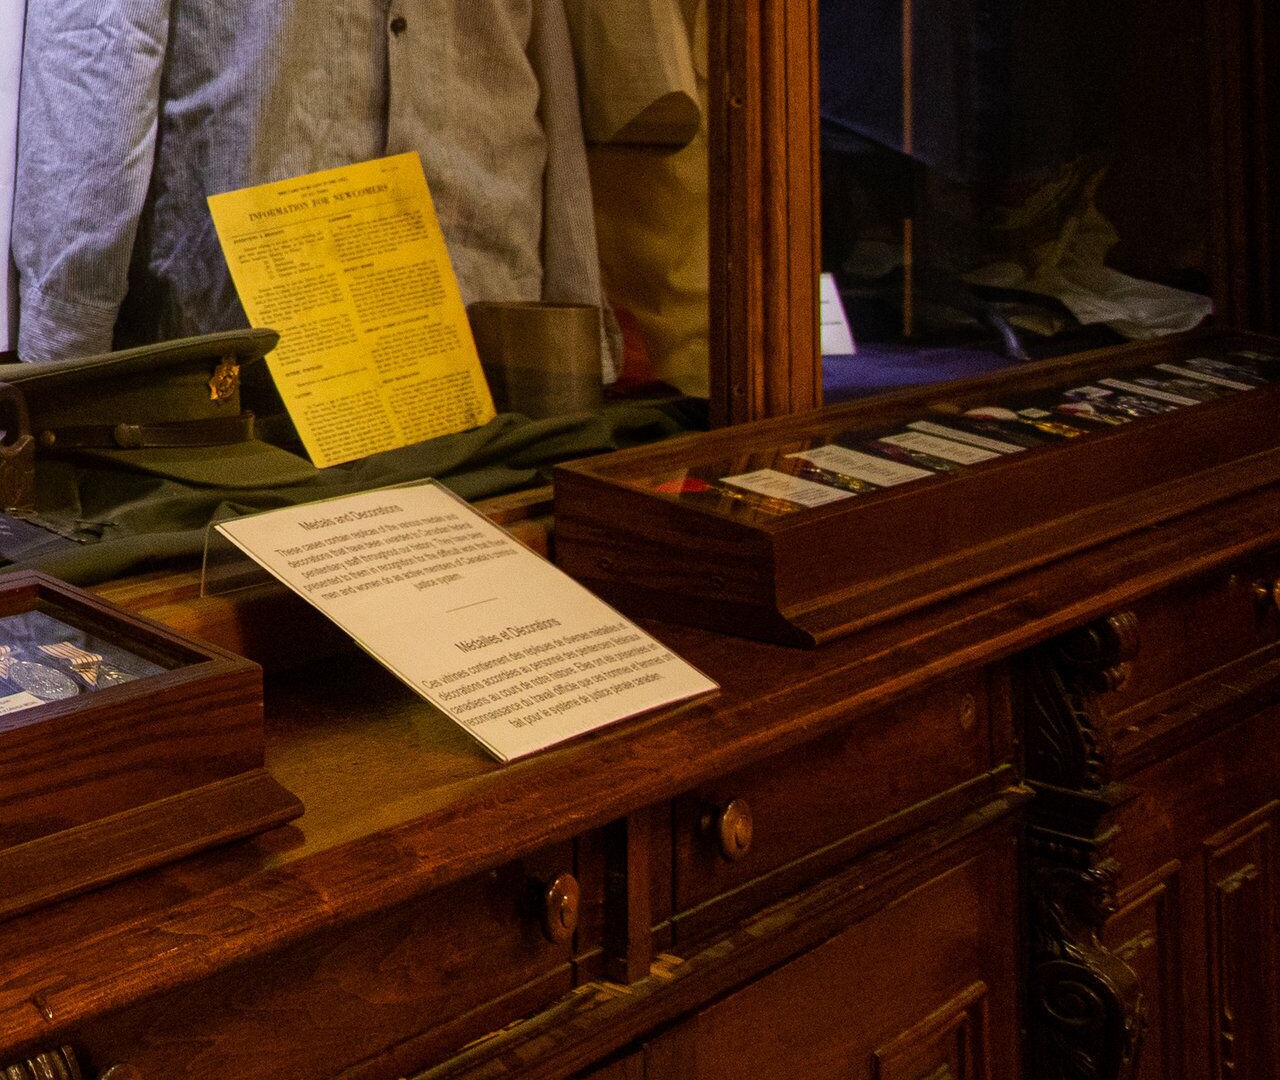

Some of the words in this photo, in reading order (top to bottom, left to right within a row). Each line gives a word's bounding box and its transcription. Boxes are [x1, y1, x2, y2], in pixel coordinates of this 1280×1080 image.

[249, 201, 309, 221] INFORMATION
[312, 196, 329, 208] FOR
[333, 184, 388, 201] NEWCOMERS
[299, 518, 335, 529] Medals
[331, 514, 353, 523] and
[349, 504, 402, 519] Decorations
[455, 633, 503, 651] Médailles
[507, 617, 560, 636] Décorations
